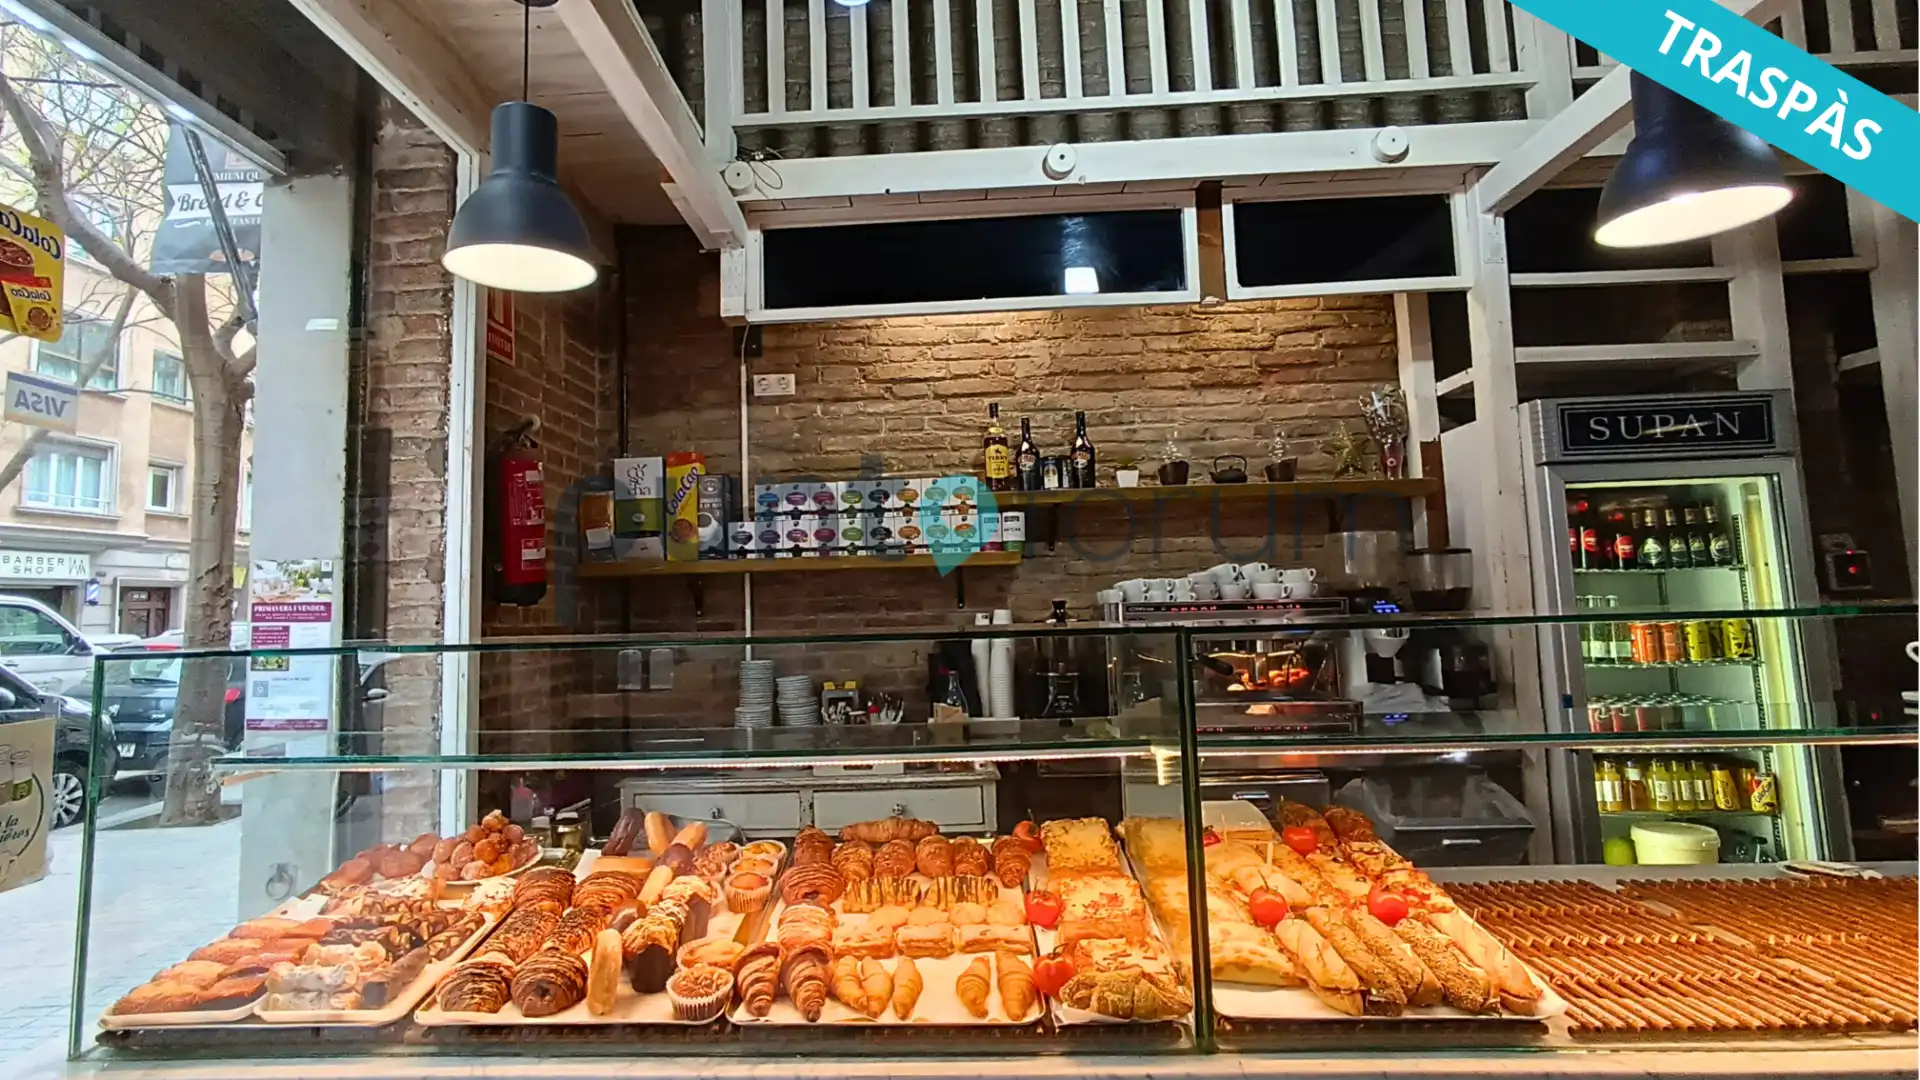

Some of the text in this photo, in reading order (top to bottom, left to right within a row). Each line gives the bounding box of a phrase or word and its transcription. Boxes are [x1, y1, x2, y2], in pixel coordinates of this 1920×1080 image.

[177, 192, 232, 212] Bred
[235, 190, 250, 210] &
[1589, 411, 1741, 440] SUPAN
[665, 466, 698, 515] ColaCao
[3, 555, 64, 566] BARBER
[13, 566, 54, 575] SHOP
